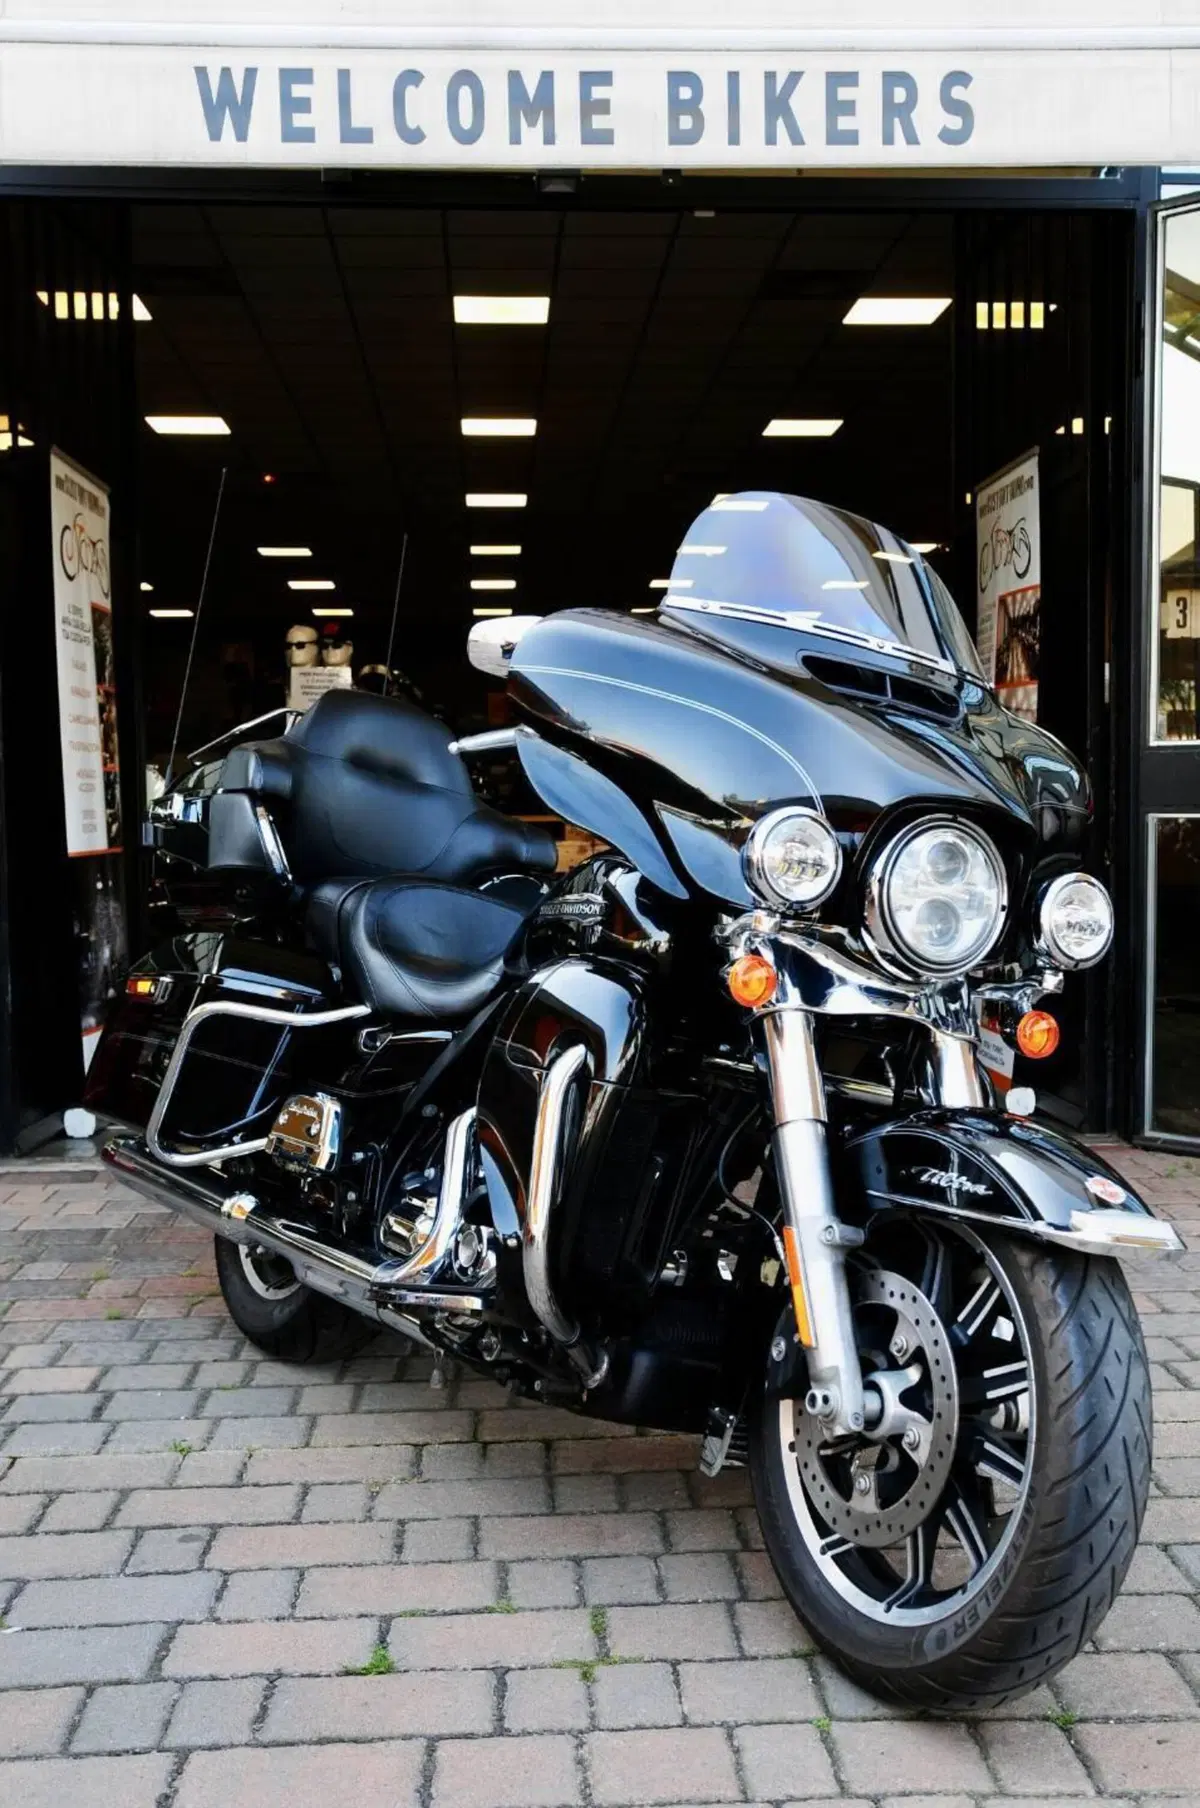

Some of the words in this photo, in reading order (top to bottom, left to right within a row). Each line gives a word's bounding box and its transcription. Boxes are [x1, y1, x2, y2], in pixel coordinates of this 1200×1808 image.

[193, 66, 615, 146] WELCOME
[667, 70, 975, 146] BIKERS
[1176, 597, 1187, 629] 3
